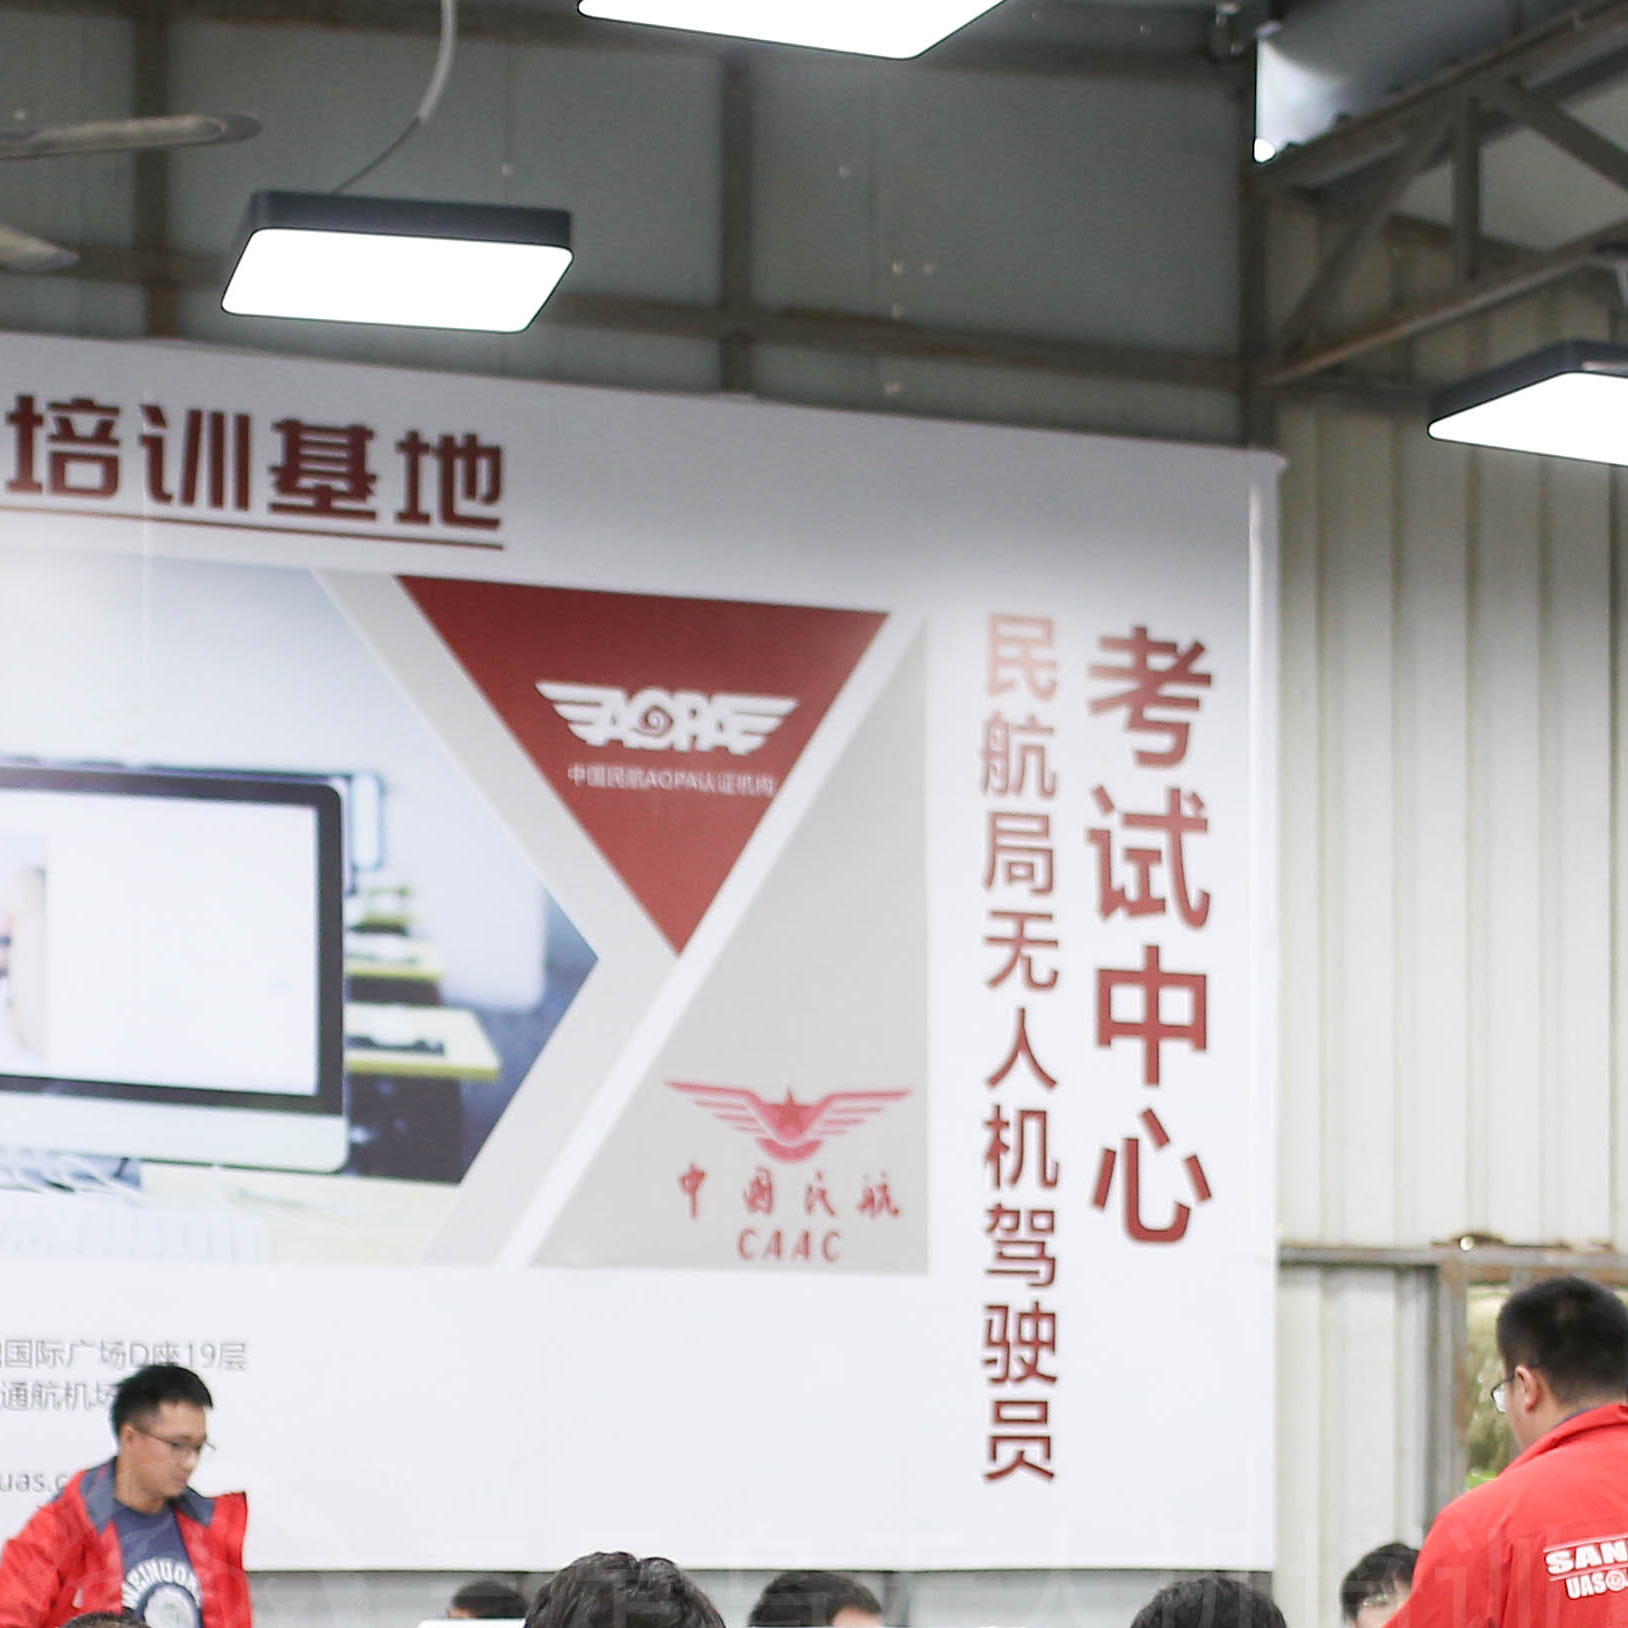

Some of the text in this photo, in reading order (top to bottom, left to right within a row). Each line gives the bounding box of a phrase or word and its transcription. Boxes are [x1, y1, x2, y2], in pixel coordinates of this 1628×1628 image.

[979, 611, 1059, 1482] 民航局无人机驾驶员
[1086, 624, 1213, 1247] 考试中心
[737, 1227, 843, 1264] CAAC
[1565, 1571, 1607, 1600] UAS
